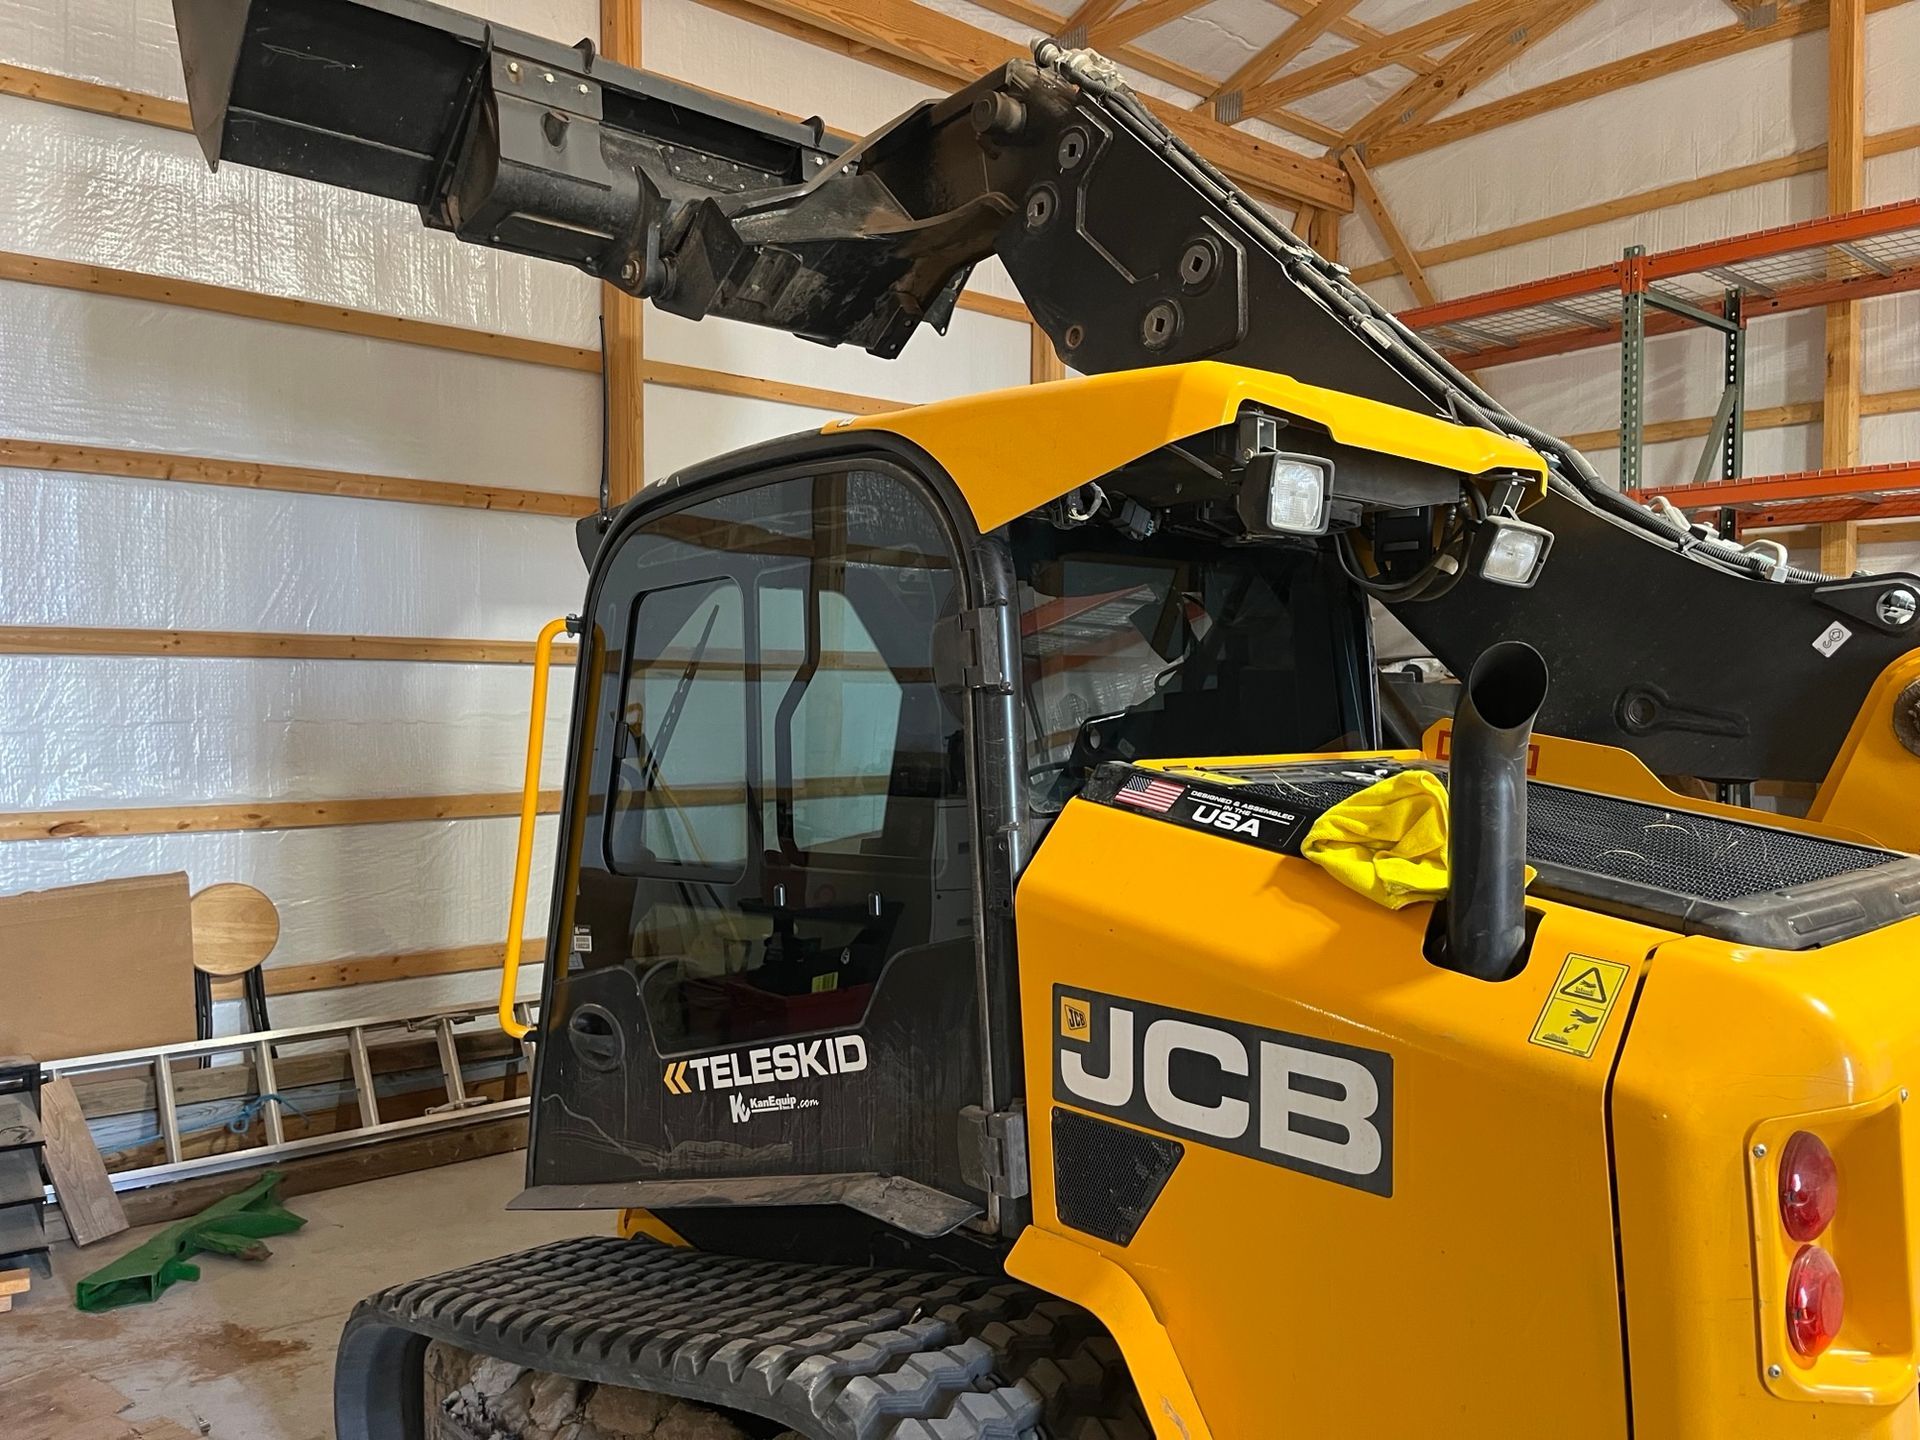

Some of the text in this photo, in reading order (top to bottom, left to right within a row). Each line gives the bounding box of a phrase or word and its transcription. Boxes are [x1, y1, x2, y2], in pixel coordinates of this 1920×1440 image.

[1190, 790, 1232, 805] DESIGNED
[1241, 803, 1295, 821] ASSEMBLED
[1191, 805, 1260, 837] USA
[1234, 807, 1252, 816] THE
[1068, 1007, 1087, 1028] JCB
[689, 1034, 868, 1091] TELESKID
[1060, 1007, 1382, 1175] JCB
